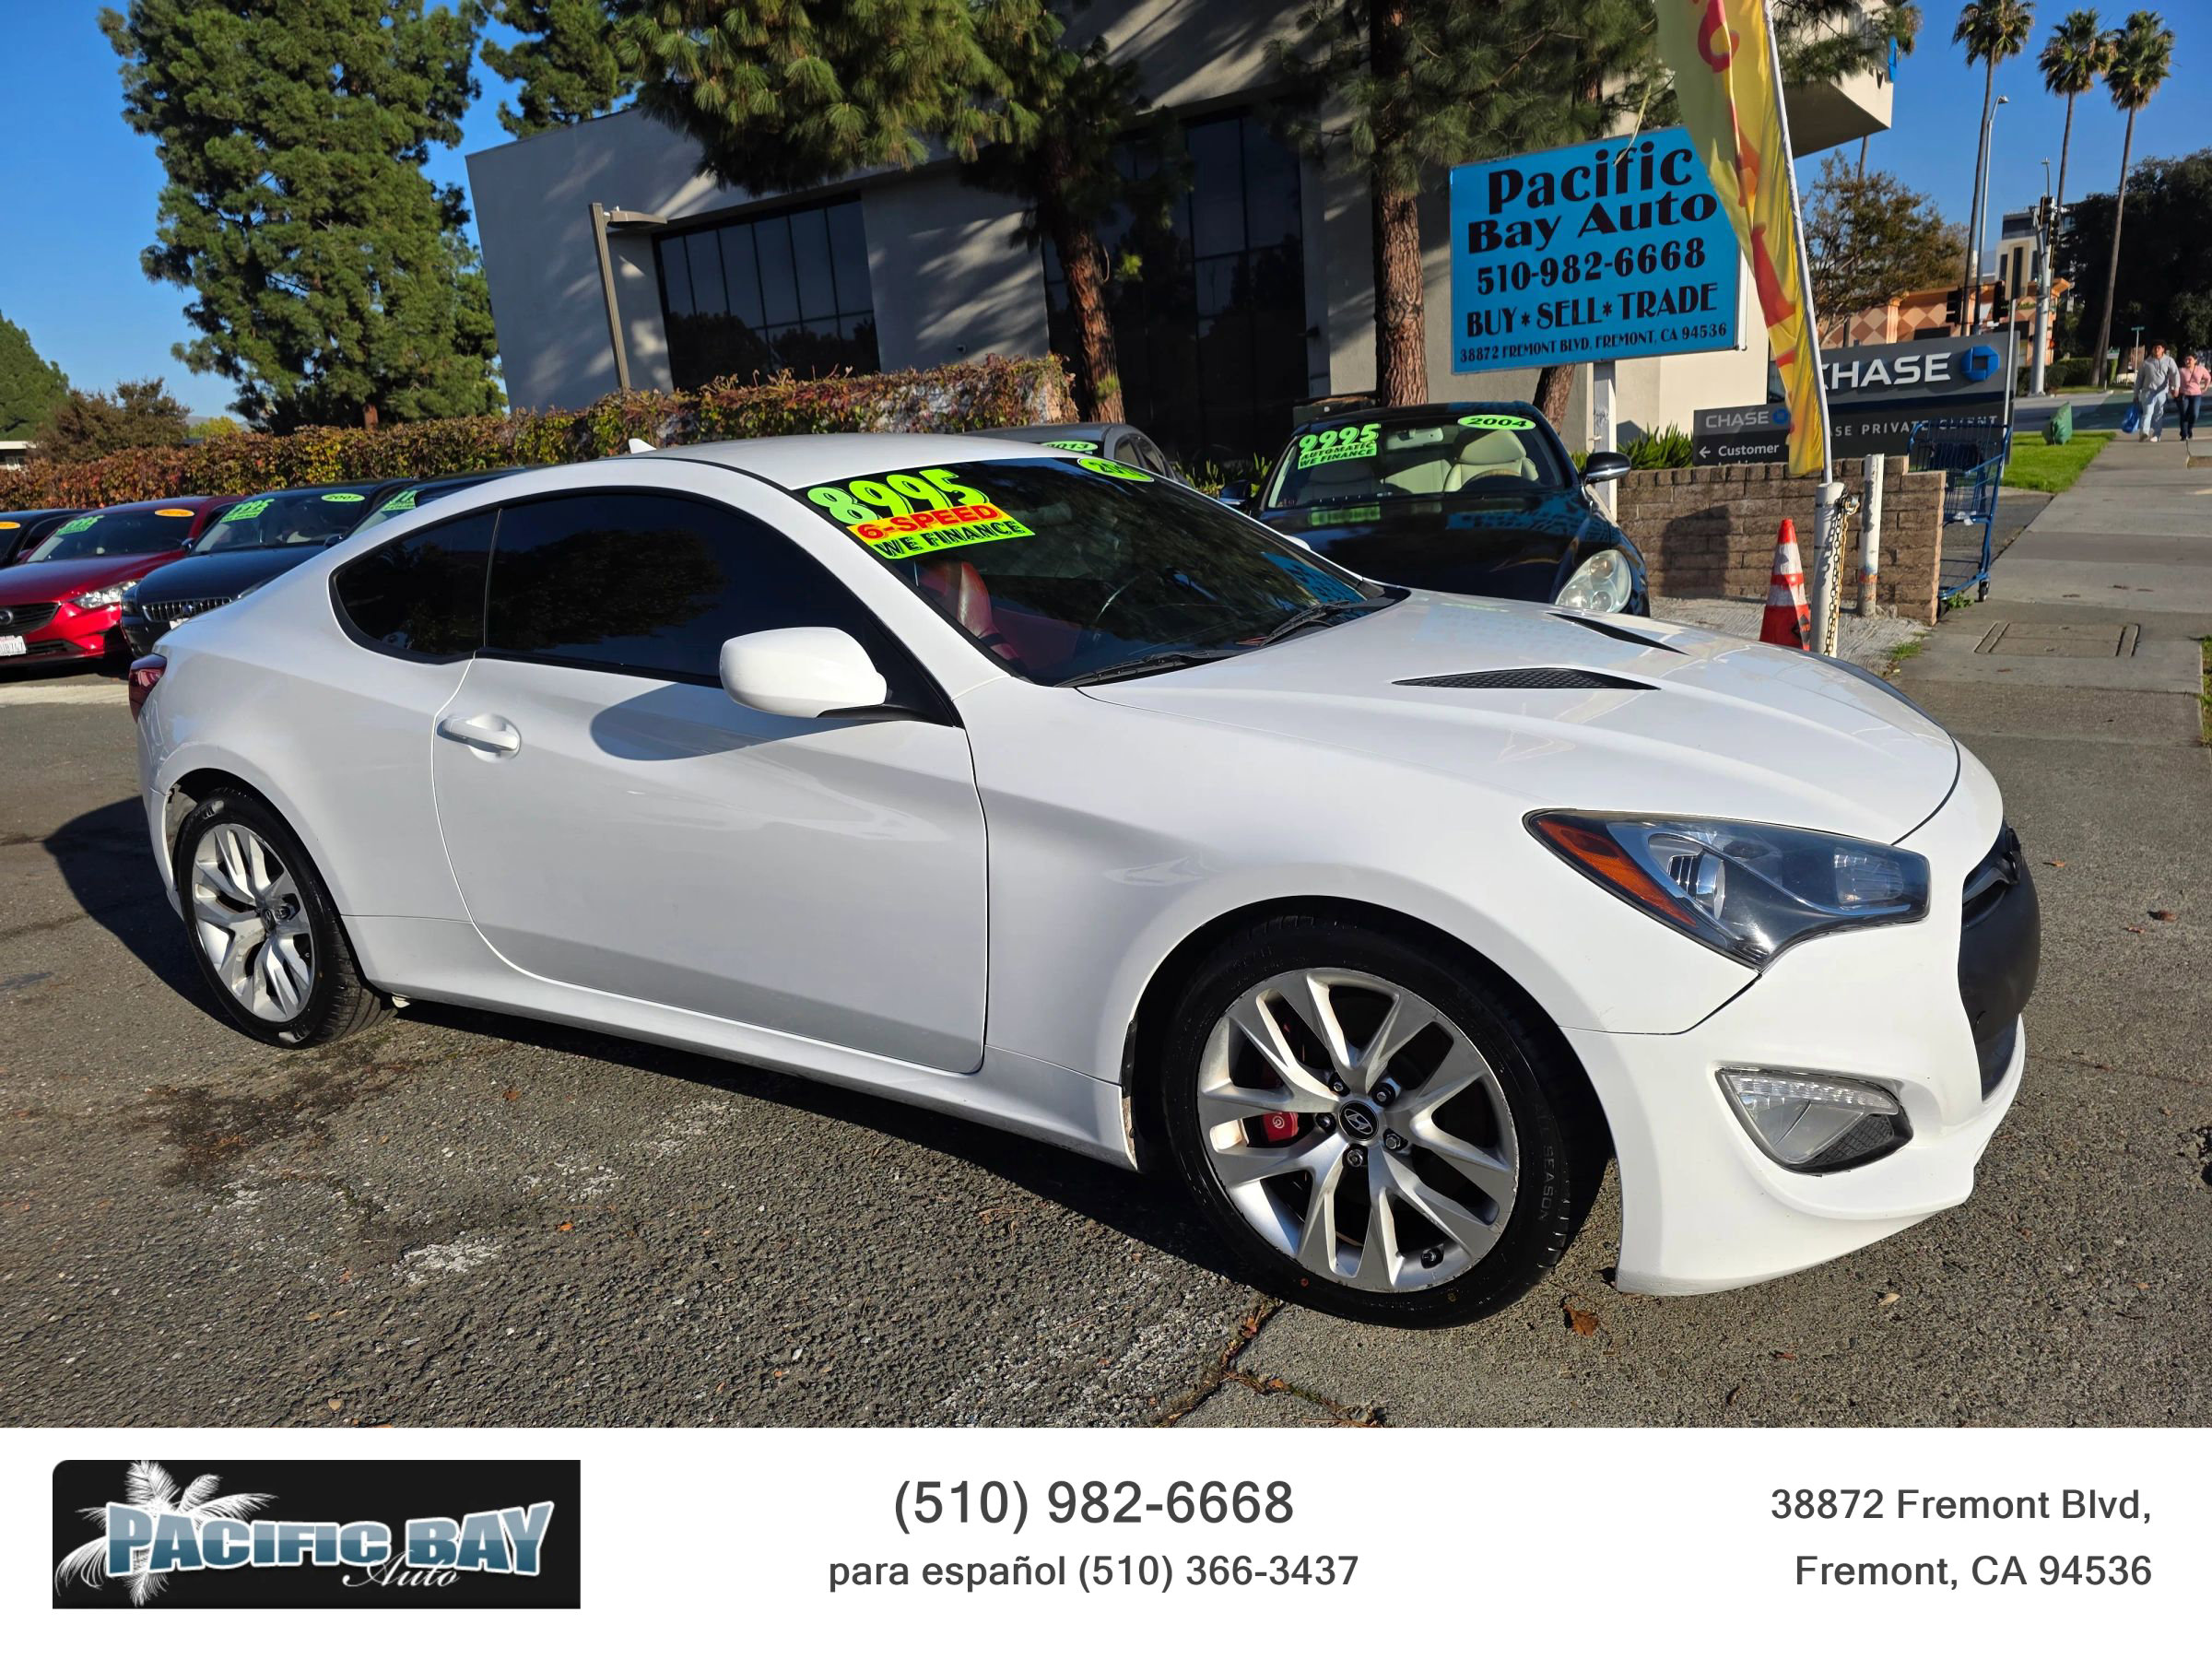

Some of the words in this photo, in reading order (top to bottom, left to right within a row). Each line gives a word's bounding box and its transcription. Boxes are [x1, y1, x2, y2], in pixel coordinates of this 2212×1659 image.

[1488, 141, 1693, 215] Pacific
[1467, 215, 1562, 254] Bay
[1577, 192, 1717, 238] Auto
[1477, 237, 1706, 295] 510-982-6668
[1466, 306, 1518, 337] BUY
[1535, 297, 1603, 329] SELL
[1618, 282, 1718, 320] TRADE
[1460, 341, 1500, 363] 38872
[1501, 340, 1557, 359] FREMONT
[1595, 330, 1657, 349] FREMONT,
[1660, 327, 1677, 342] CA
[1681, 323, 1727, 340] 94536
[1299, 423, 1382, 453] 9995
[1467, 416, 1527, 428] 2004
[1705, 411, 1770, 429] CHASE
[1300, 457, 1319, 466] WE
[1320, 448, 1374, 463] FINANCE
[1301, 441, 1373, 460] AUTOMATIC
[1718, 442, 1780, 456] Customer
[806, 468, 991, 526] 8995
[857, 504, 1001, 541] 6-SPEED
[874, 536, 923, 559] WE
[924, 519, 1023, 547] FINANCE
